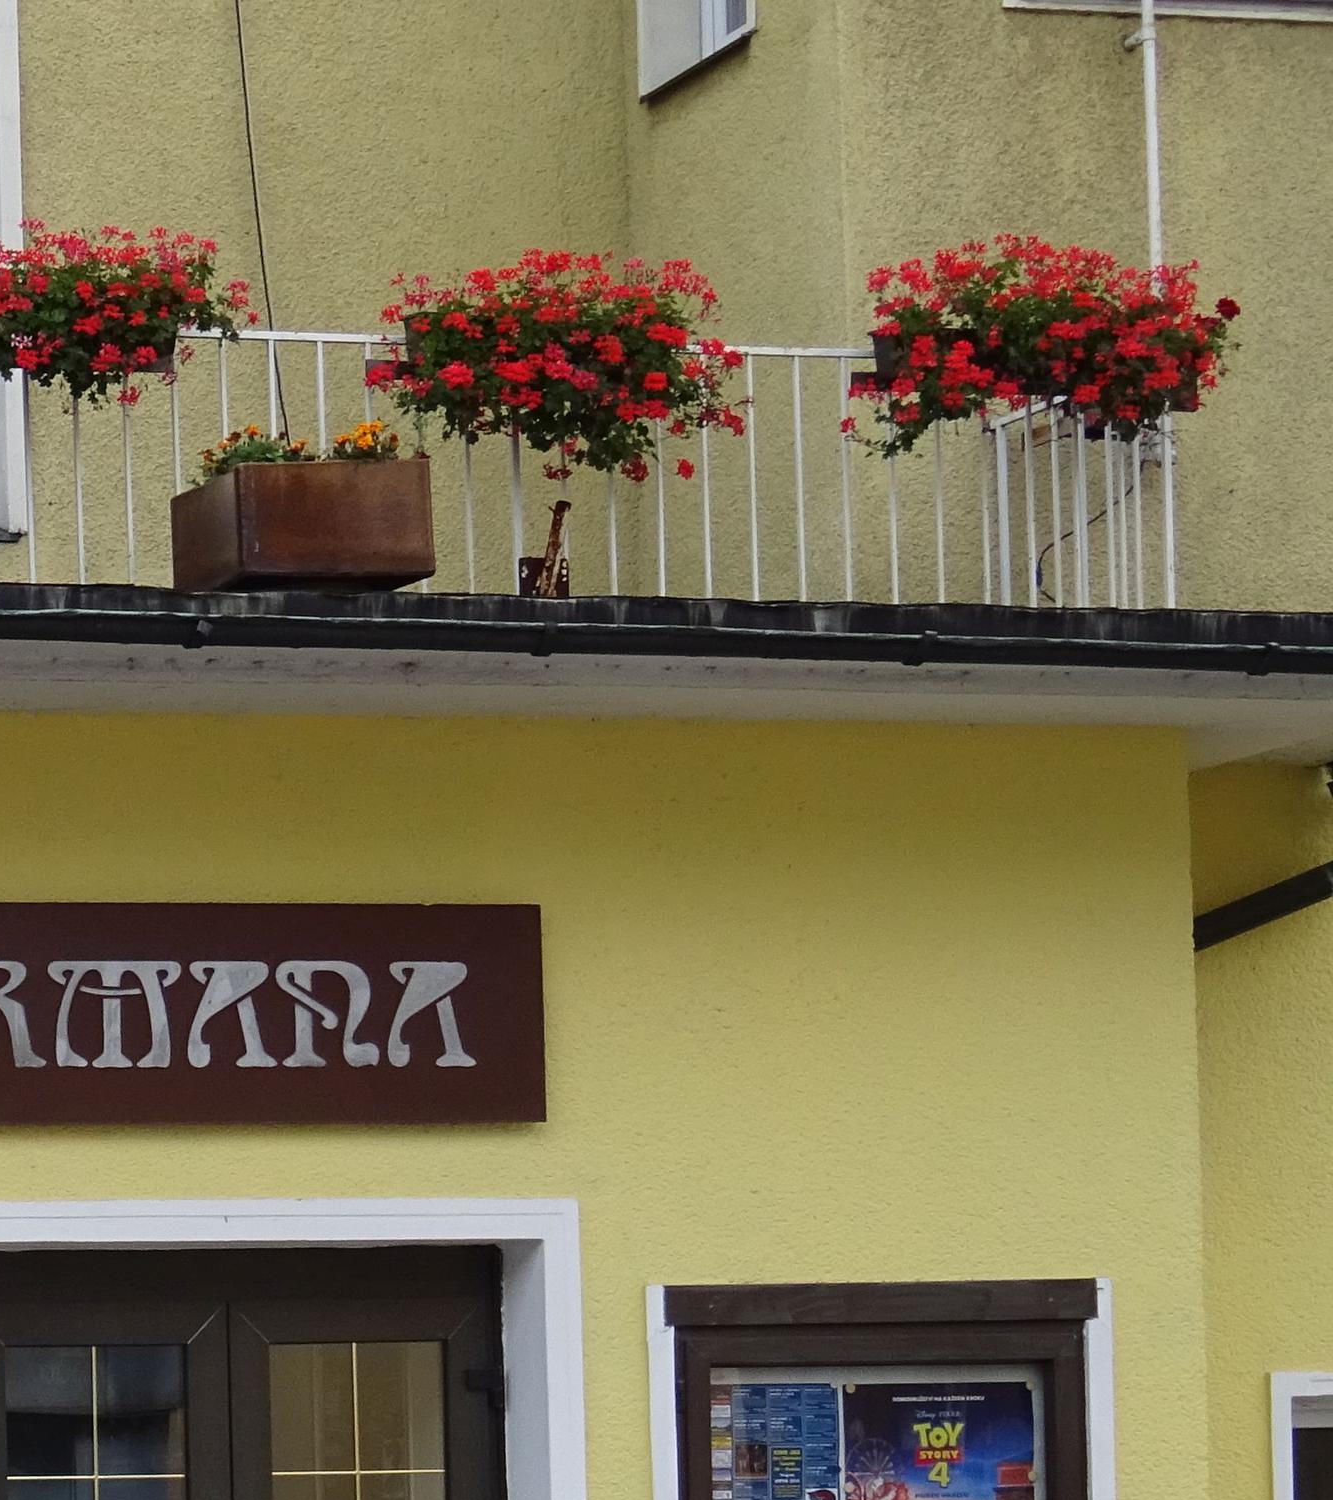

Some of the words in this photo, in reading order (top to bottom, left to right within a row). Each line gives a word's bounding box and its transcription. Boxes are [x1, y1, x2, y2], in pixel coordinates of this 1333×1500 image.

[913, 1423, 965, 1449] TOY
[919, 1450, 959, 1460] STORY
[928, 1461, 951, 1488] 4
